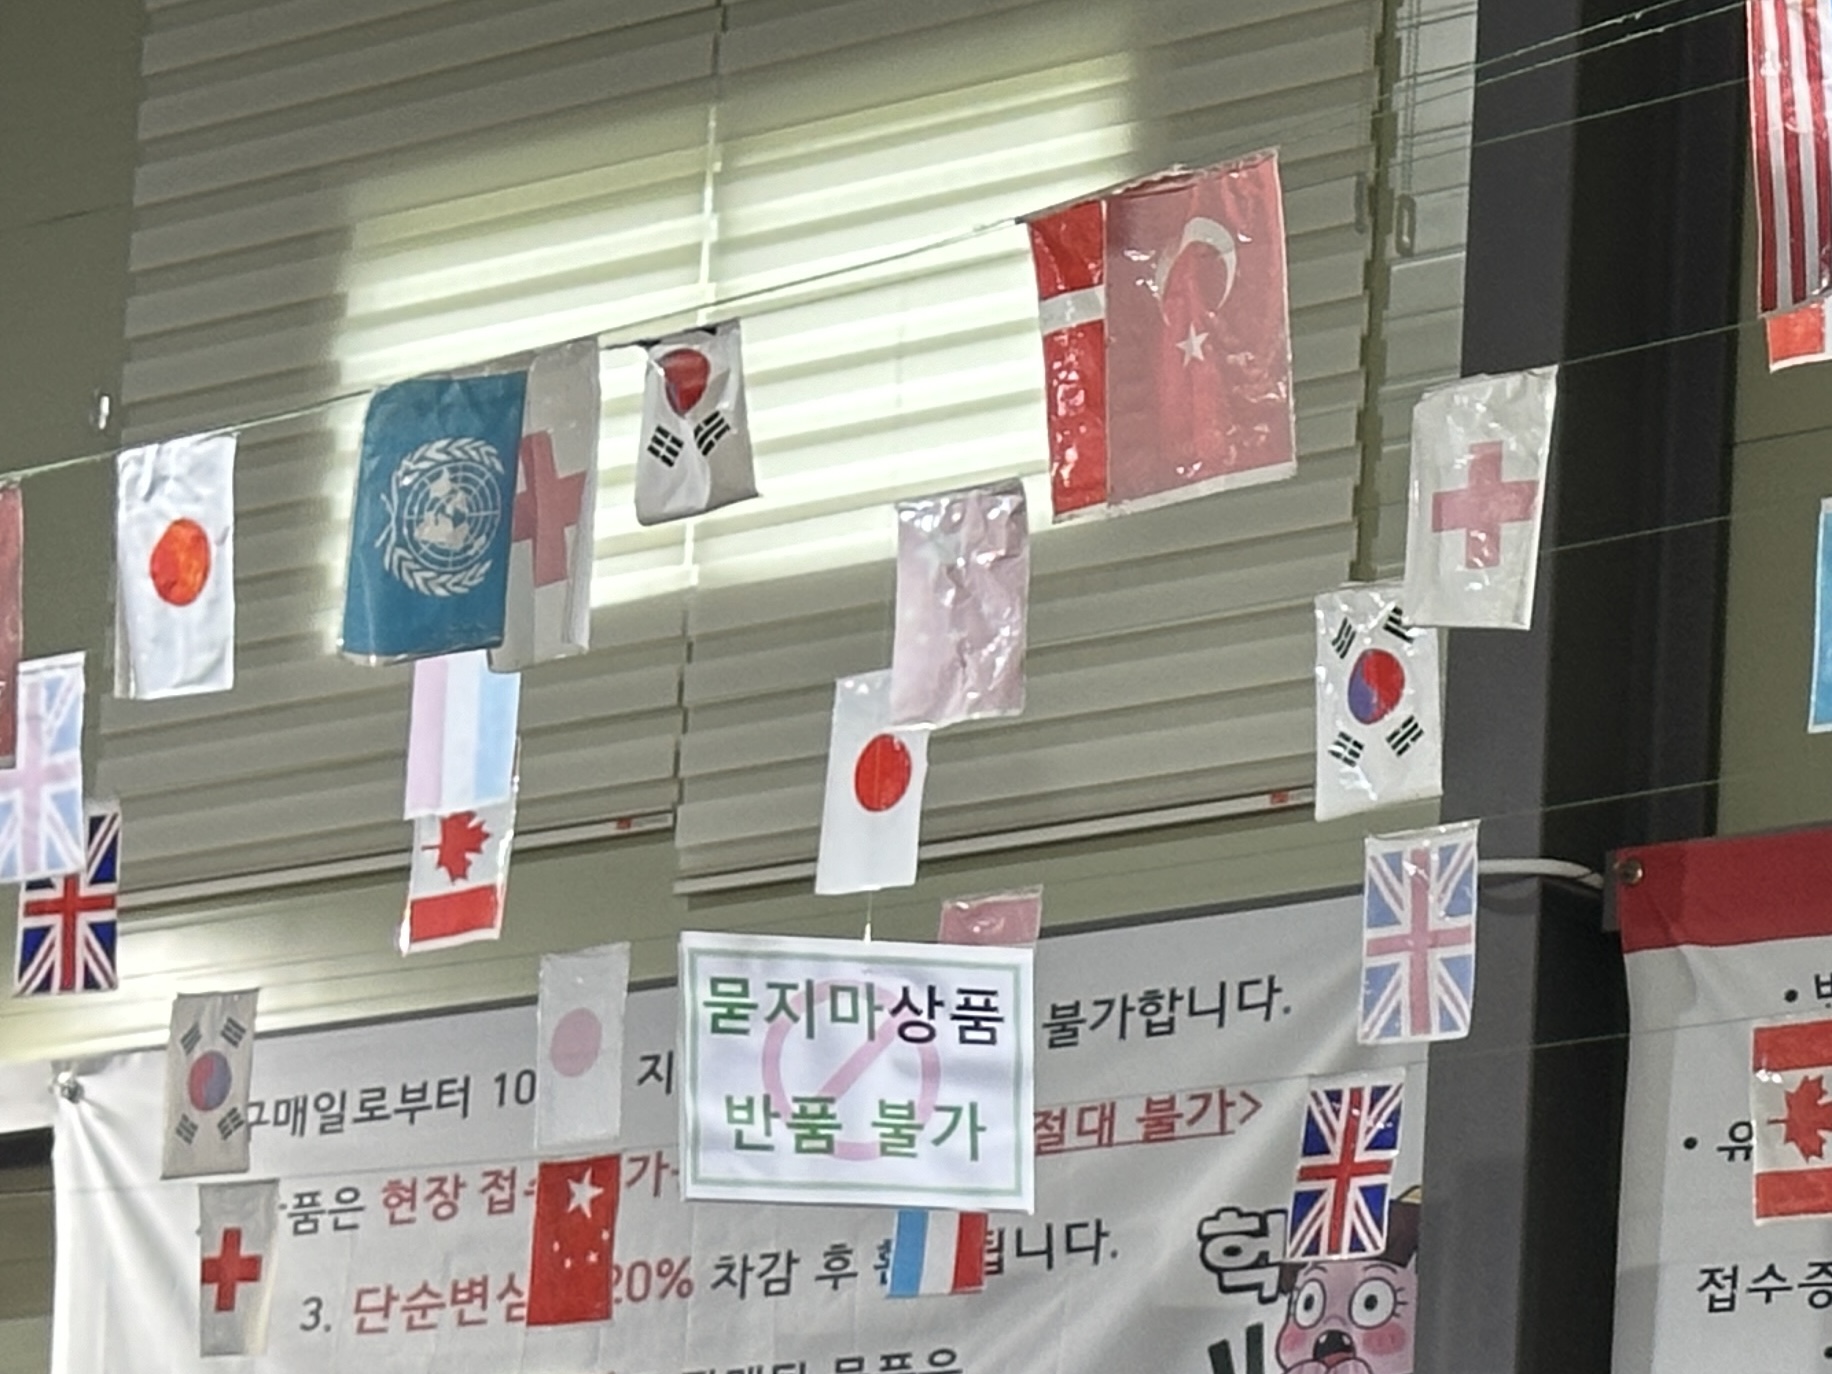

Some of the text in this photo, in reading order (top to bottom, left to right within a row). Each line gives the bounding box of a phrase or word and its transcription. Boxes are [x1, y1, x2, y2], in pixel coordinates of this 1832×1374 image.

[704, 977, 1004, 1046] 묻지마상품
[1042, 975, 1290, 1049] 불가합니다.
[725, 1094, 986, 1161] 반품 불가
[278, 1184, 366, 1236] 품은
[382, 1174, 466, 1226] 현장
[1034, 1101, 1116, 1150] 절대
[300, 1297, 331, 1332] 3.
[711, 1249, 800, 1300] 차감
[815, 1244, 858, 1291] 후
